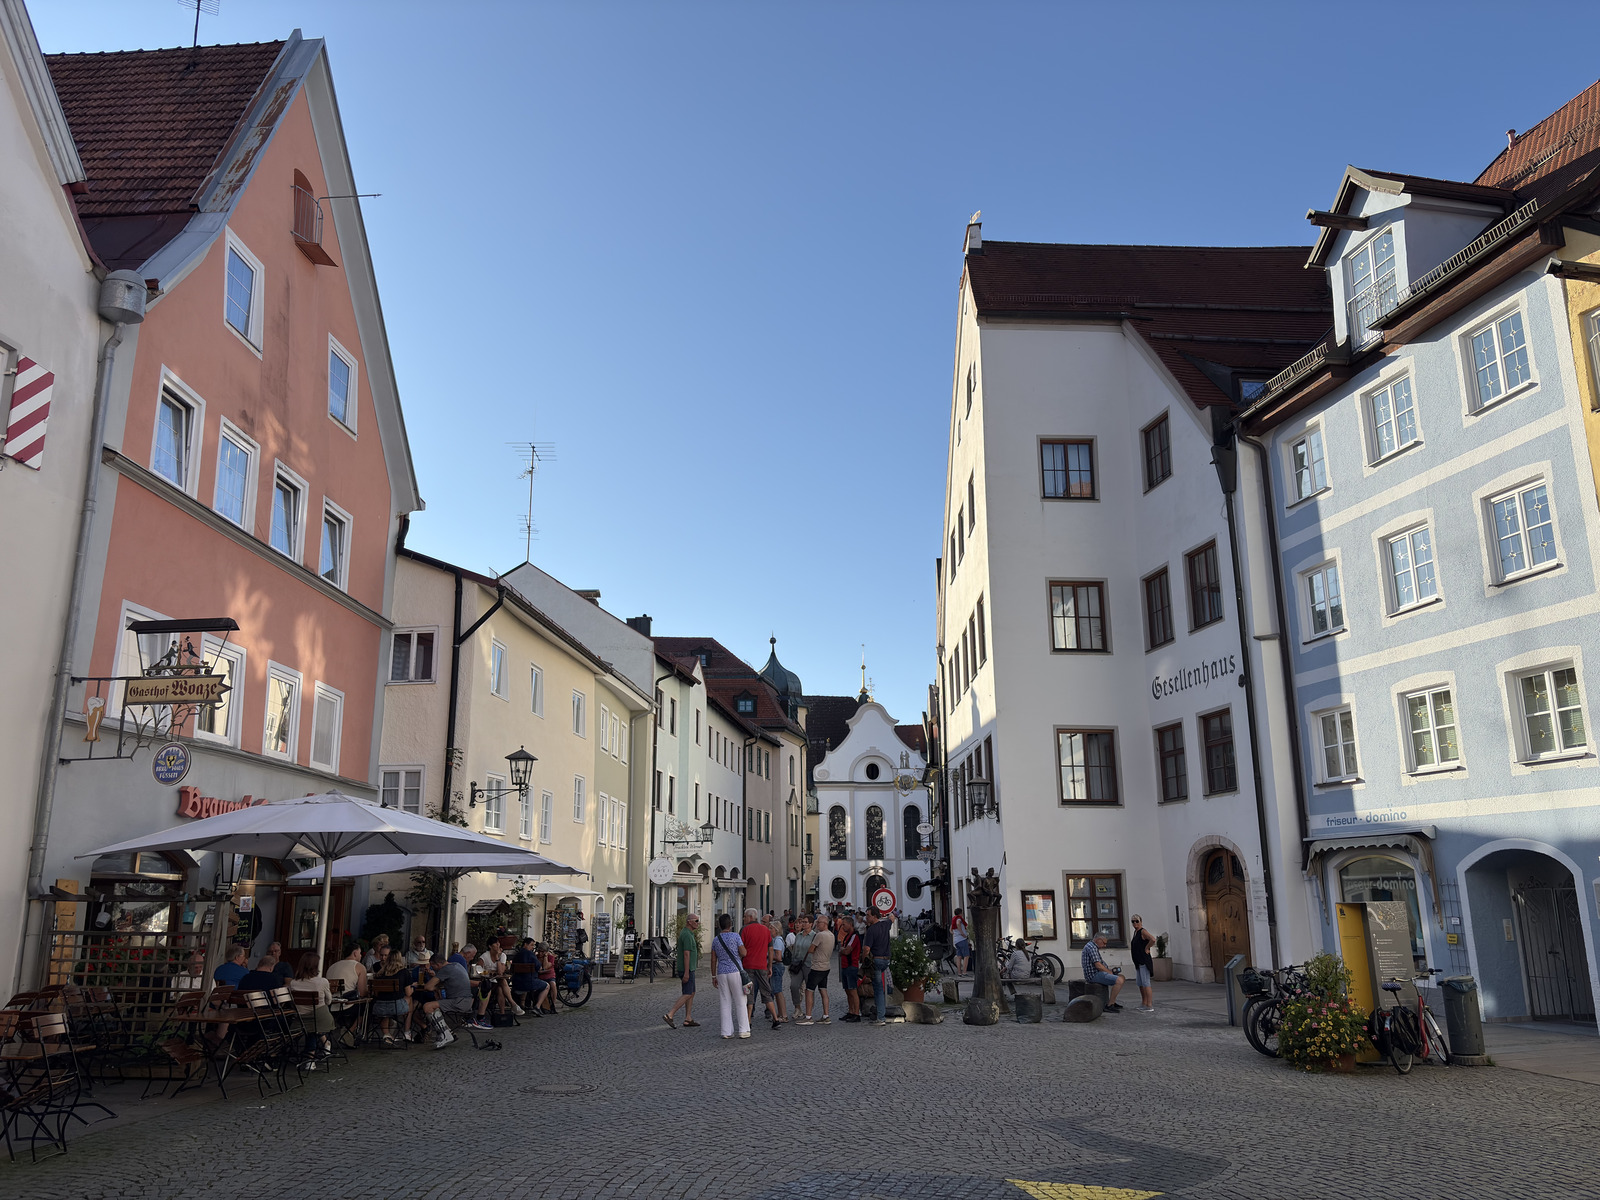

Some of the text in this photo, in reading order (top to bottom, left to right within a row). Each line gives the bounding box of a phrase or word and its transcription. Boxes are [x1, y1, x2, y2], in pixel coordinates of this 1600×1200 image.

[1152, 655, 1236, 700] Gesellenhaus
[129, 679, 218, 699] Gasthof Woaze
[1326, 817, 1358, 827] friseur
